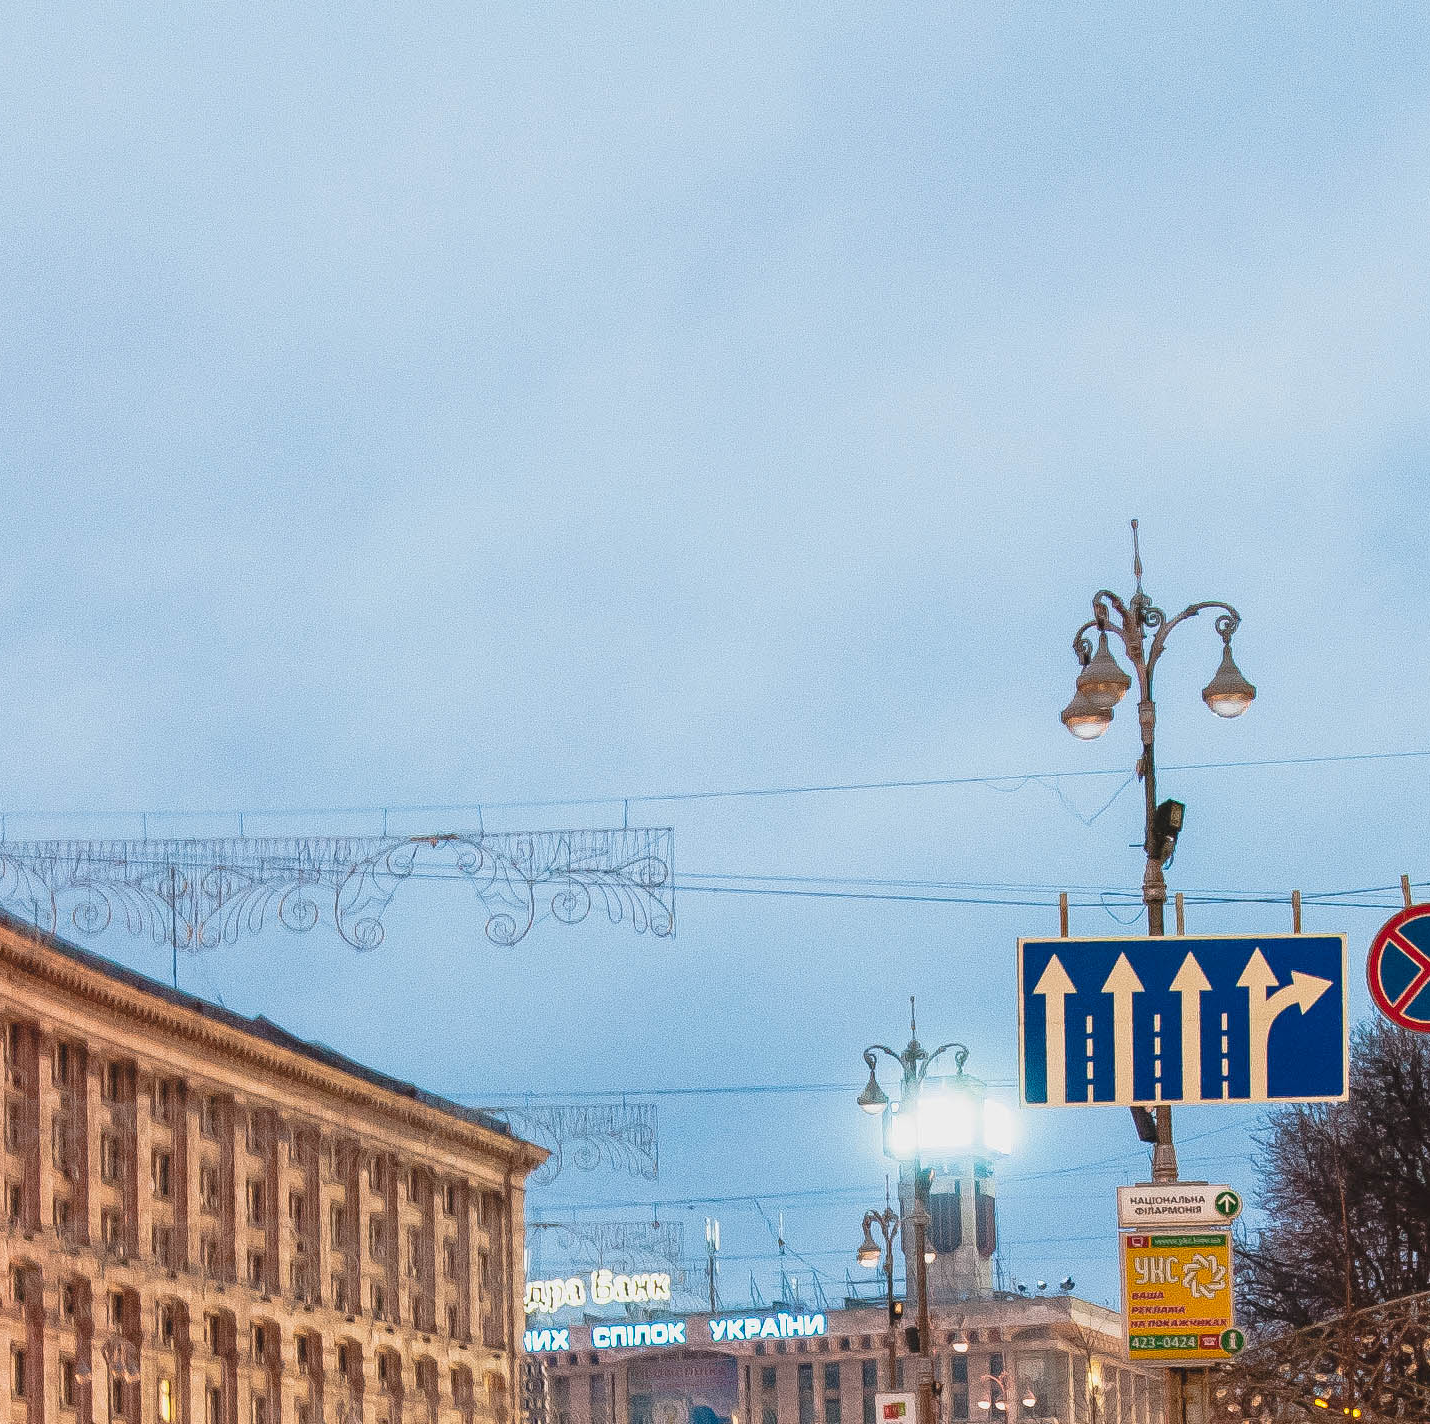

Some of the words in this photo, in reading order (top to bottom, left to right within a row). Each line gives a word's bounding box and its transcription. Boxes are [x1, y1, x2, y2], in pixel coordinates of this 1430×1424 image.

[1129, 1195, 1206, 1205] НАЦІОНАЛЬНА
[1134, 1205, 1202, 1215] ФІЛАРМОНІЯ
[1131, 1306, 1186, 1315] РЕКЛАМА
[592, 1323, 686, 1347] СПІЛОК
[710, 1313, 825, 1341] УКРАЇНИ
[1131, 1336, 1196, 1349] 423-0424
